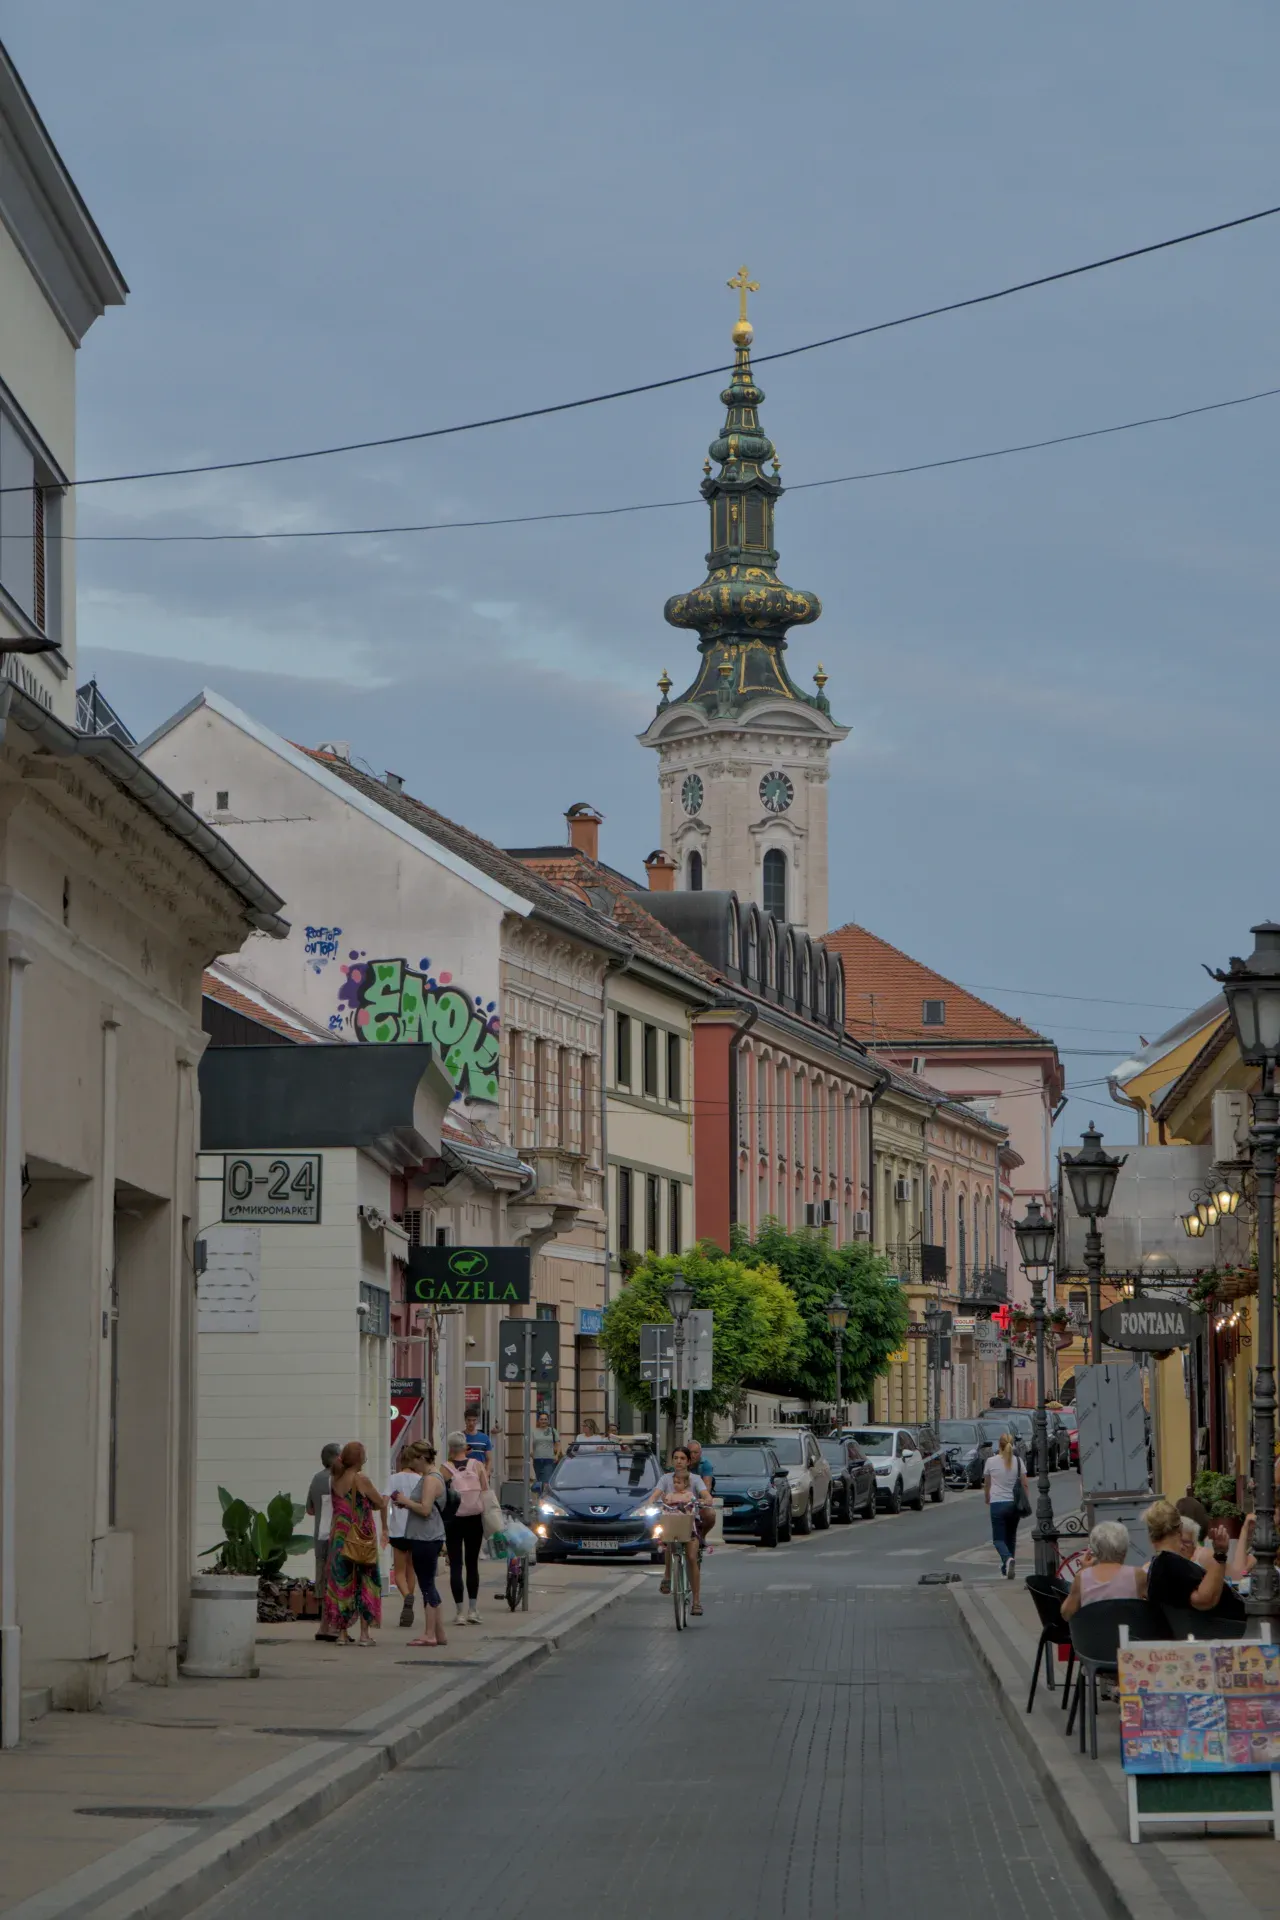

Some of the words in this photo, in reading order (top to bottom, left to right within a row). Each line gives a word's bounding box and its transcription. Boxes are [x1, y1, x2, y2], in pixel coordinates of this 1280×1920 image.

[304, 926, 342, 942] ROOFTOP
[304, 943, 317, 955] ON
[316, 941, 338, 960] TOP!
[228, 1159, 316, 1200] 0-24
[241, 1206, 315, 1216] МИКРОМАРКЕТ
[414, 1278, 520, 1301] GAZELA
[1120, 1311, 1186, 1336] FONTANA
